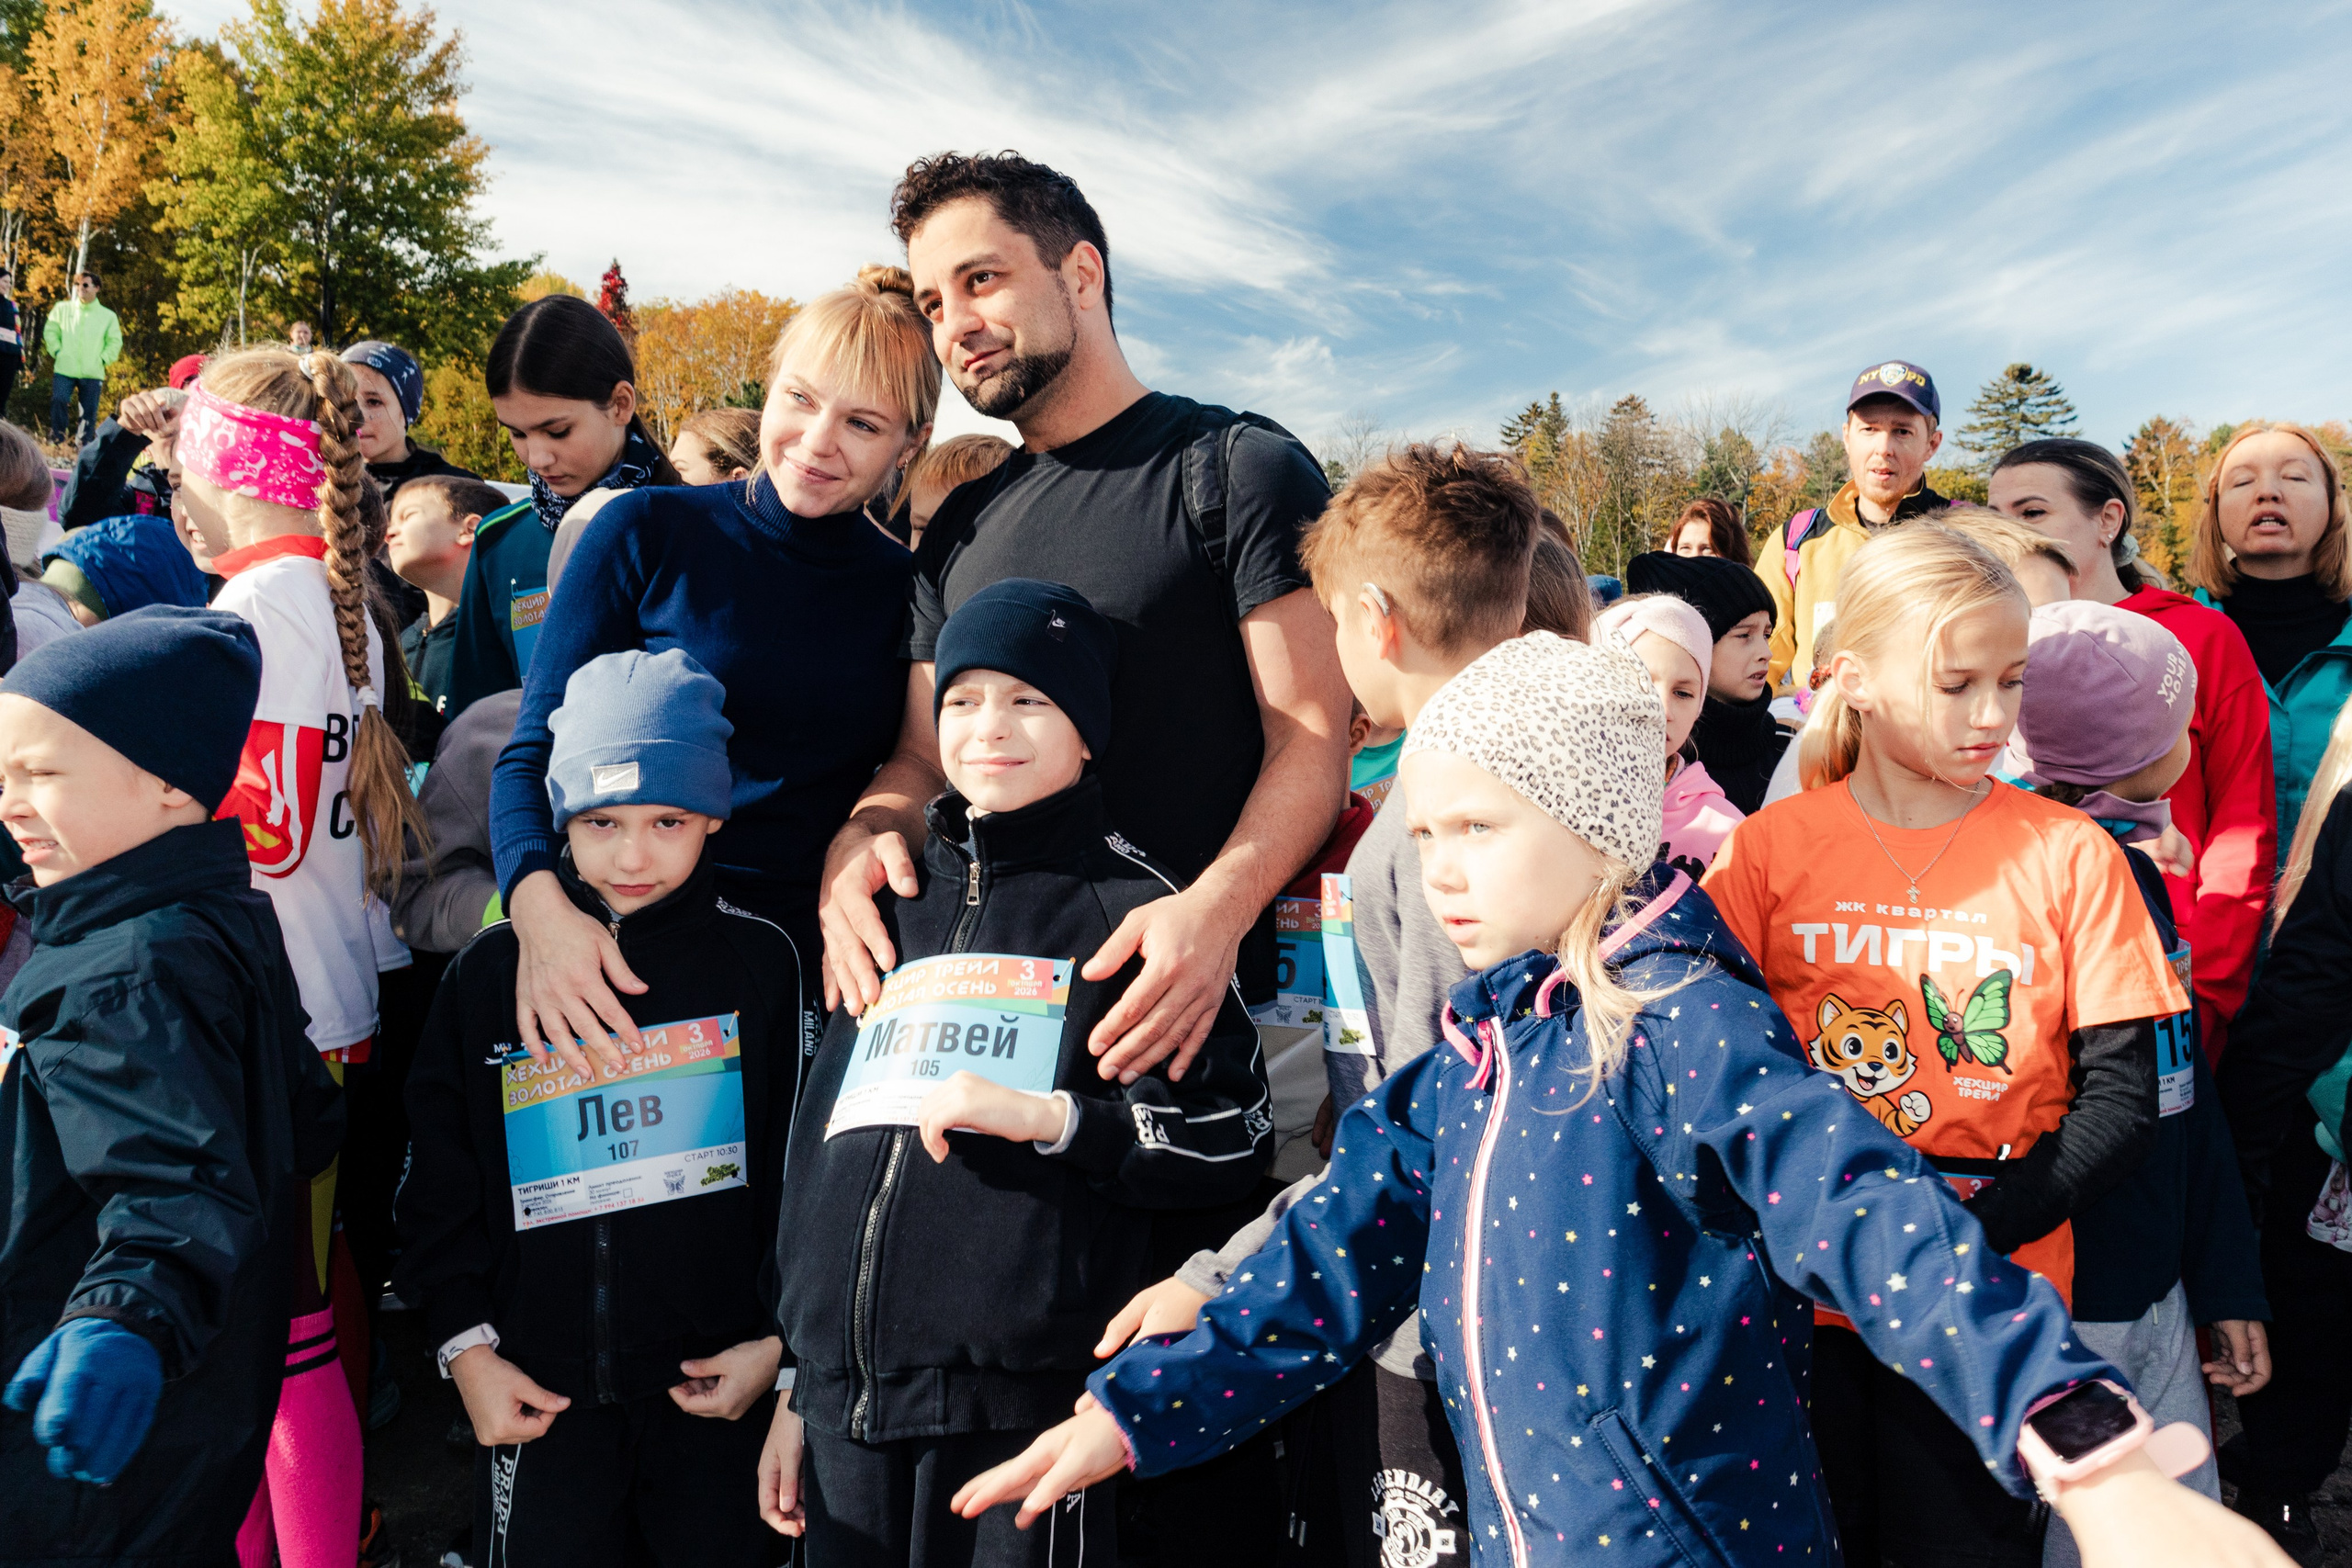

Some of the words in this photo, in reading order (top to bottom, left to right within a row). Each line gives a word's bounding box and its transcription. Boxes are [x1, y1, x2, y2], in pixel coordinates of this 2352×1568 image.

[1858, 369, 1881, 385] NY
[1905, 370, 1926, 387] PD
[514, 609, 545, 626] ЗОЛОТА
[1834, 900, 1867, 913] ЖК
[1792, 922, 2035, 987] ТИГРЫ
[933, 960, 1001, 978] ТРЕЙЛ
[1020, 959, 1035, 980] 3
[932, 979, 998, 997] ОСЕНЬ
[688, 1022, 704, 1043] 3
[803, 1010, 815, 1056] MILANO
[865, 1014, 1020, 1062] Матвей
[910, 1059, 941, 1077] 105
[1952, 1076, 2009, 1093] ХЕХЦИР
[1957, 1087, 2001, 1102] ТРЕЙЛ
[577, 1094, 663, 1142] Лев
[607, 1139, 639, 1161] 107
[684, 1149, 715, 1163] СТАРТ
[716, 1145, 739, 1157] 10:30
[517, 1180, 560, 1196] ТИГРИШИ
[567, 1176, 580, 1186] КМ
[497, 1454, 514, 1536] PRADA
[1370, 1468, 1461, 1518] LEGENDARY
